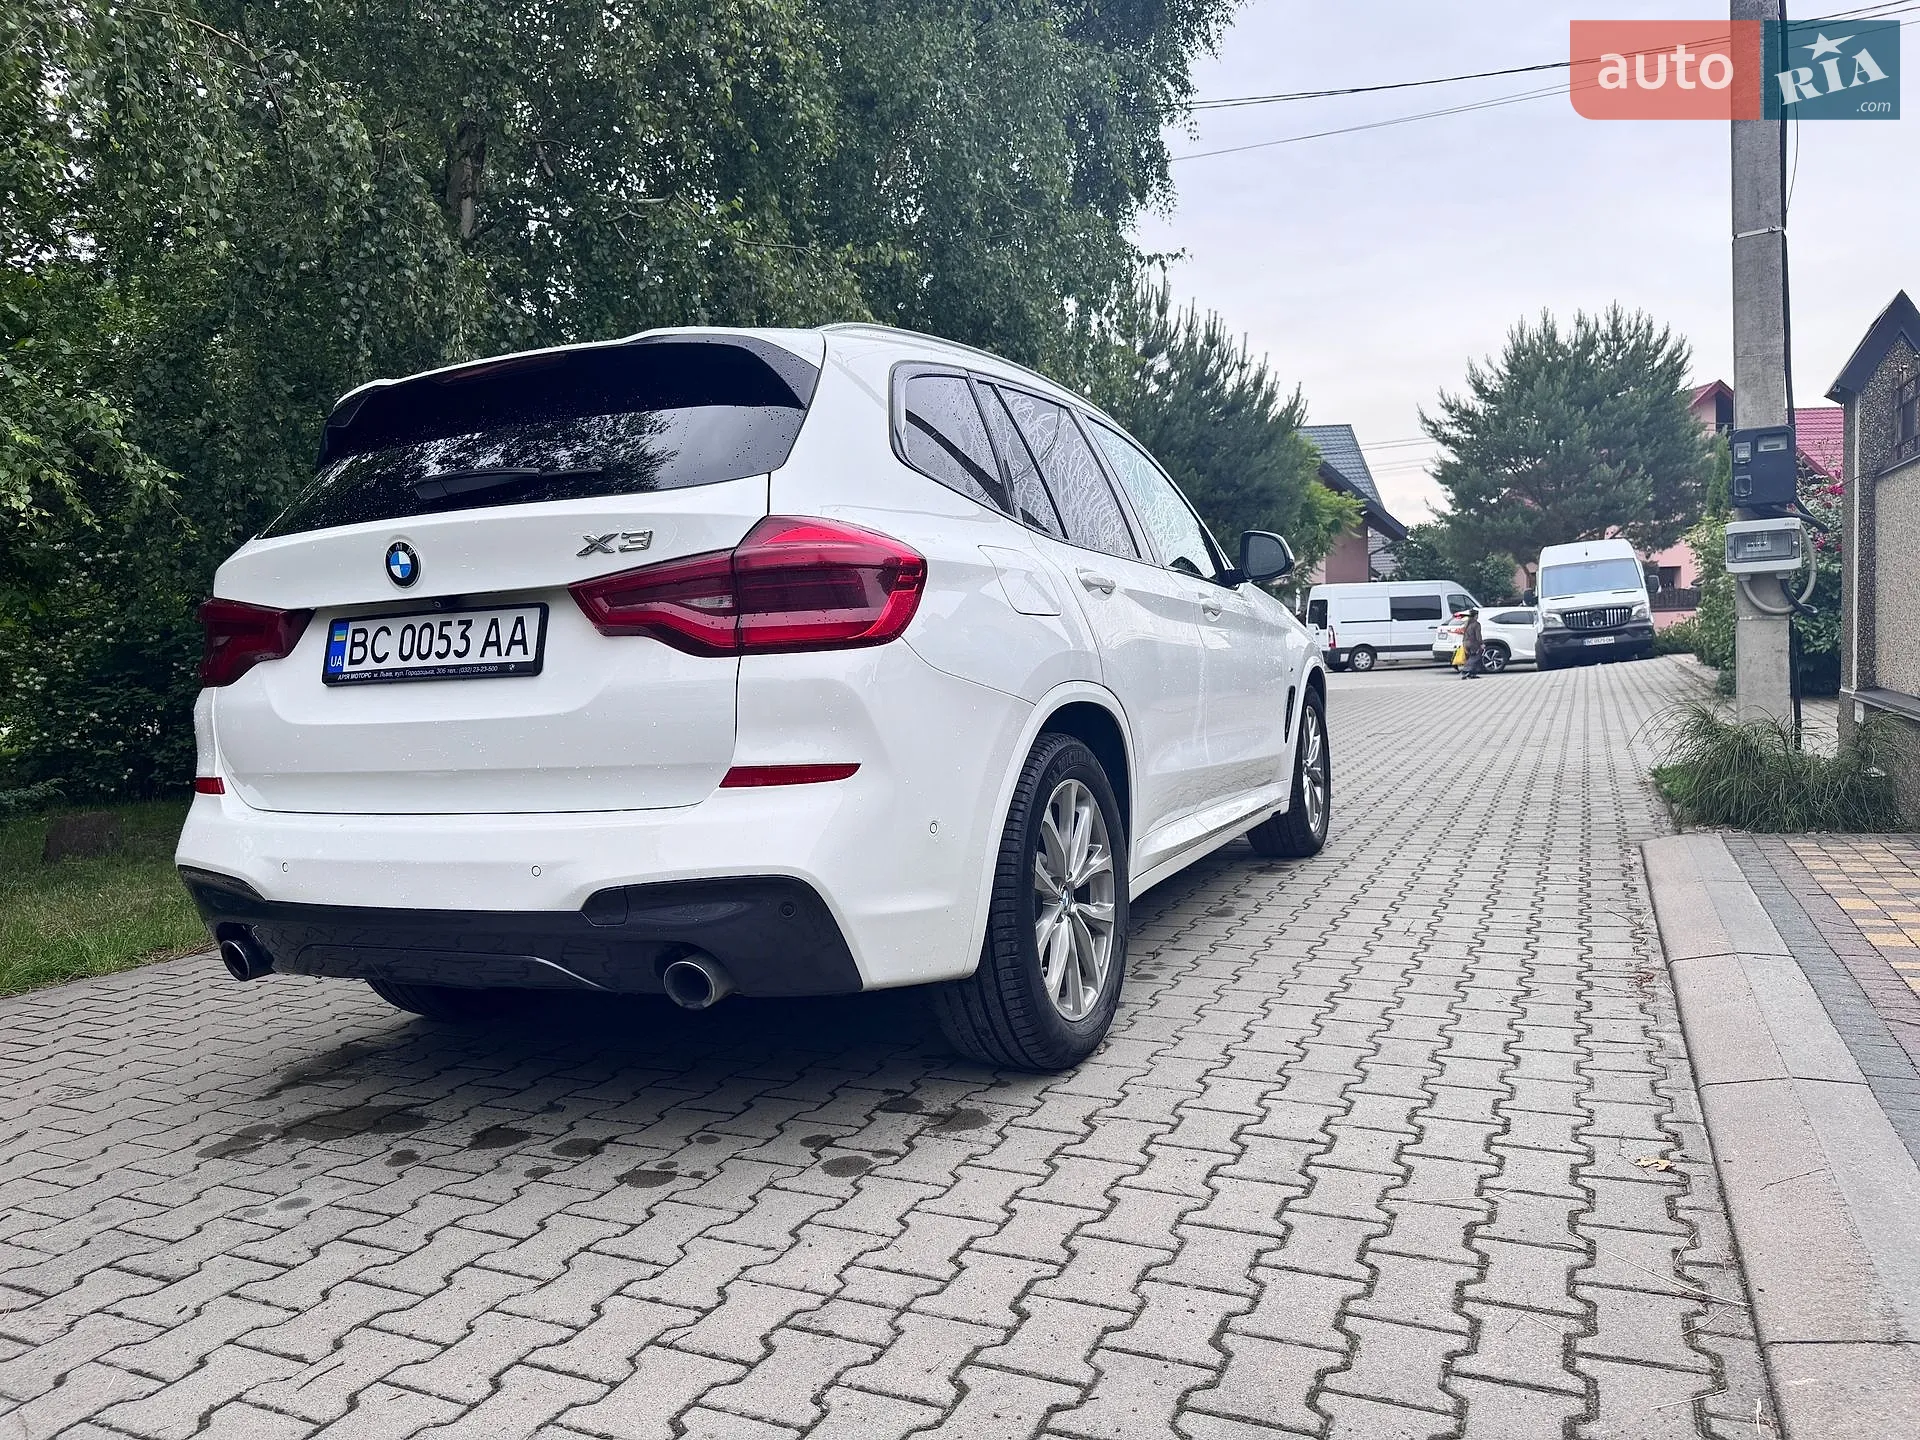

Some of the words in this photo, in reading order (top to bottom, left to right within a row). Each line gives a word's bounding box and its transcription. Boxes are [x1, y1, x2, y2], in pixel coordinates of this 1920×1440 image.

[576, 530, 653, 557] X3
[348, 626, 392, 666] BC
[399, 619, 473, 662] 0053
[480, 615, 529, 658] AA
[330, 655, 342, 667] UA
[473, 665, 499, 673] 23-23-500
